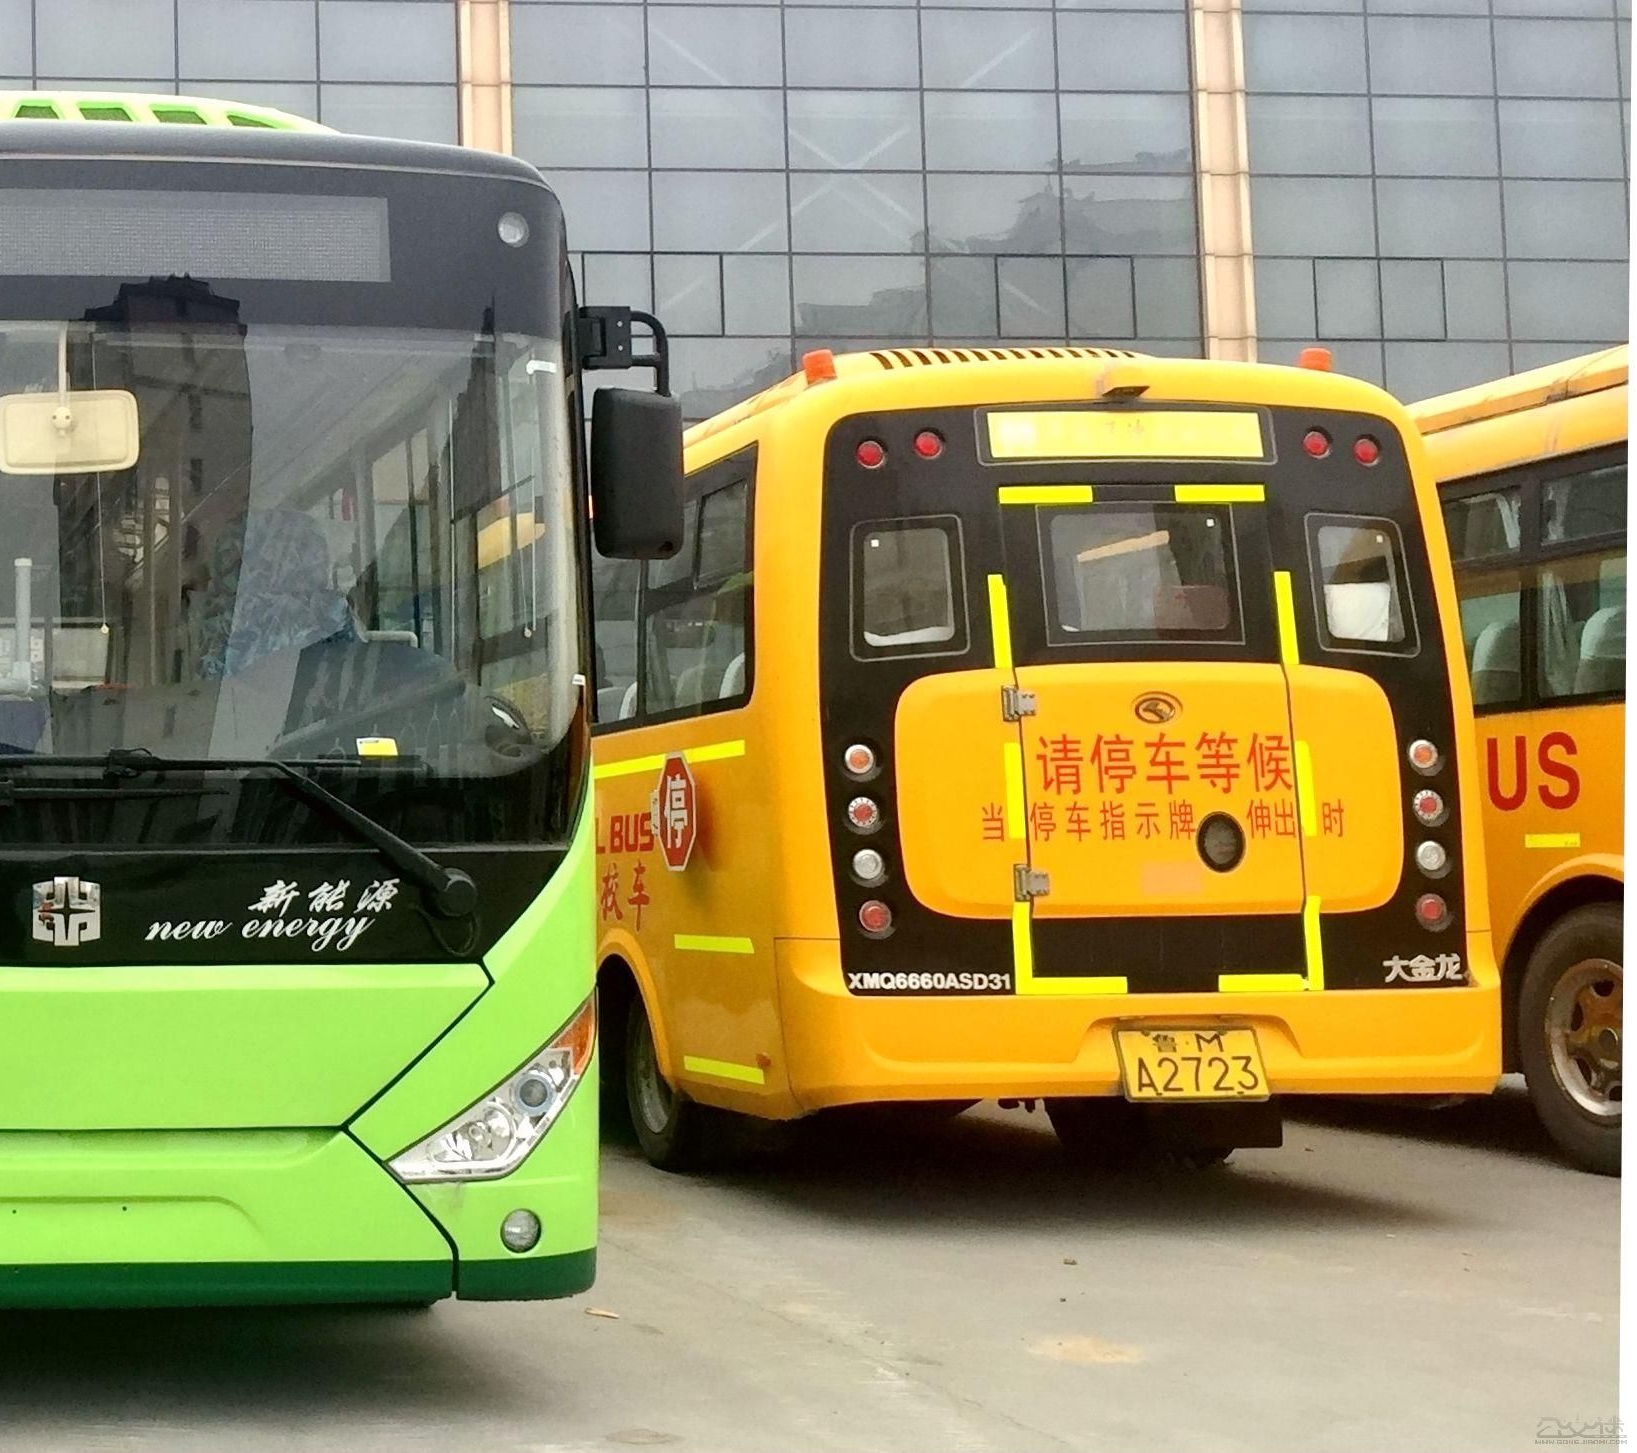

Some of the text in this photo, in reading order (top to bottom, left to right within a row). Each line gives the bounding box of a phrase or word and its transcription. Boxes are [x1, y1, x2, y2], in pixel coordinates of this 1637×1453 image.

[1036, 731, 1294, 796] 请停车等候
[1486, 731, 1581, 812] US
[664, 773, 688, 849] 停
[610, 812, 654, 854] BUS
[247, 879, 401, 918] 新能源
[600, 857, 651, 932] 校车
[144, 916, 376, 952] new energy
[848, 972, 1012, 990] XMQ6660ASD31
[1382, 952, 1463, 983] 大金龙
[1137, 1055, 1259, 1093] A2723
